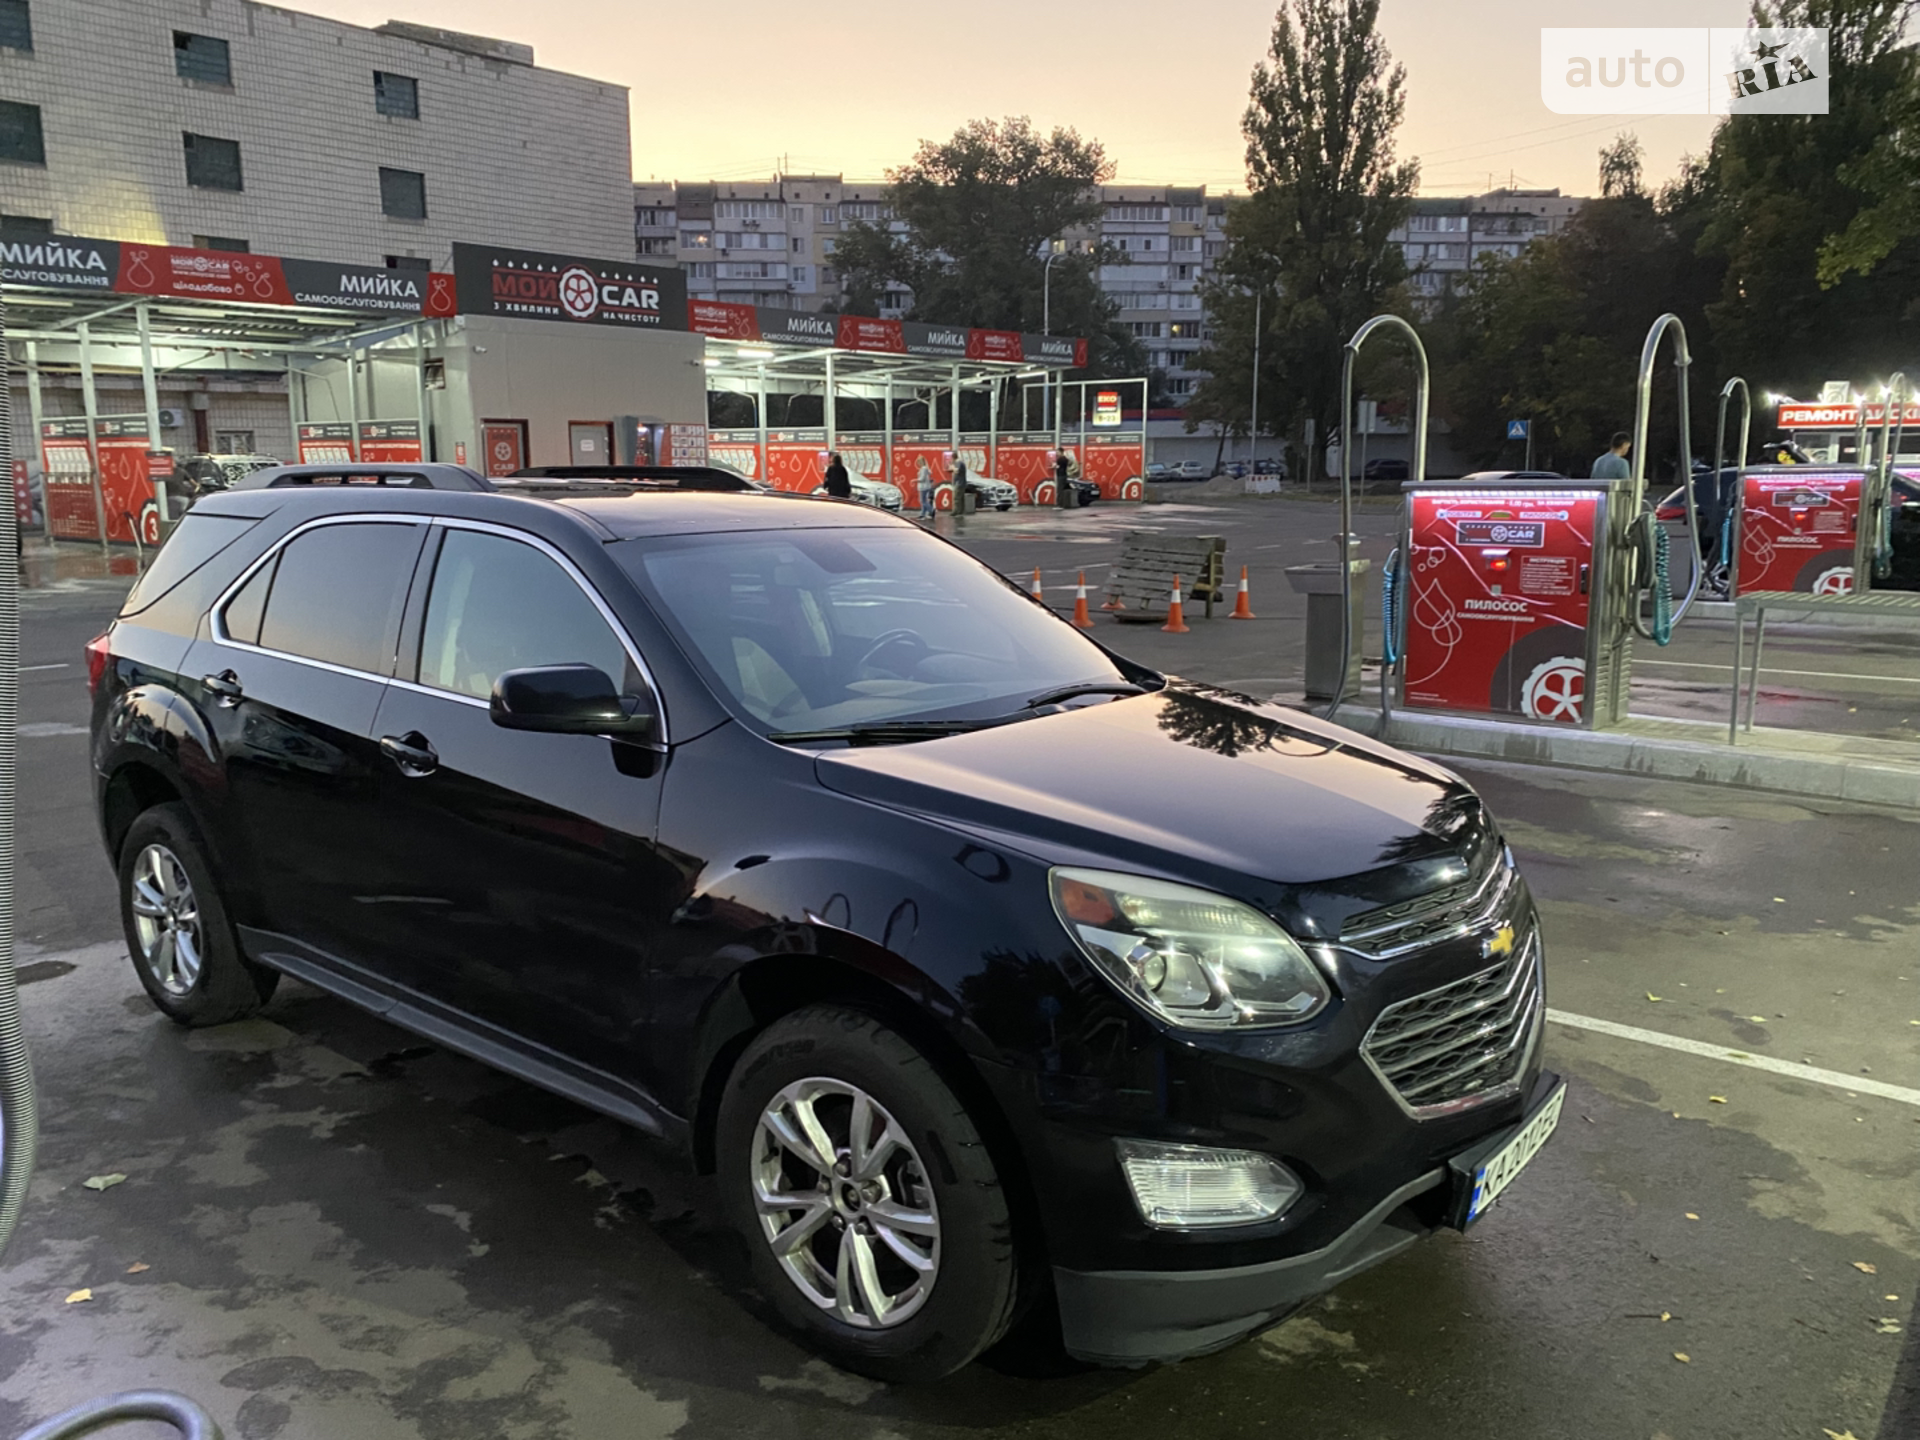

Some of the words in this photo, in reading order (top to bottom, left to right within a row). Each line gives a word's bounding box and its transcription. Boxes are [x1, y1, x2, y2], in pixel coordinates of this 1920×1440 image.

[0, 241, 107, 271] МИЙКА
[340, 273, 420, 298] МИЙКА
[295, 292, 421, 311] САМООБСЛУГОВУВАННЯ
[602, 285, 660, 310] CAR
[506, 303, 559, 315] ХВИЛИНИ
[603, 311, 616, 320] НА
[617, 313, 660, 323] ЧИСТОТУ
[788, 317, 834, 335] МИЙКА
[928, 330, 966, 347] МИЙКА
[1781, 409, 1858, 422] РЕМОНТ
[942, 493, 950, 507] 6
[1044, 489, 1052, 502] 7
[1131, 485, 1139, 498] 8
[150, 517, 159, 541] 3
[1508, 530, 1535, 539] CAR
[1465, 599, 1528, 613] ПИЛОСОС
